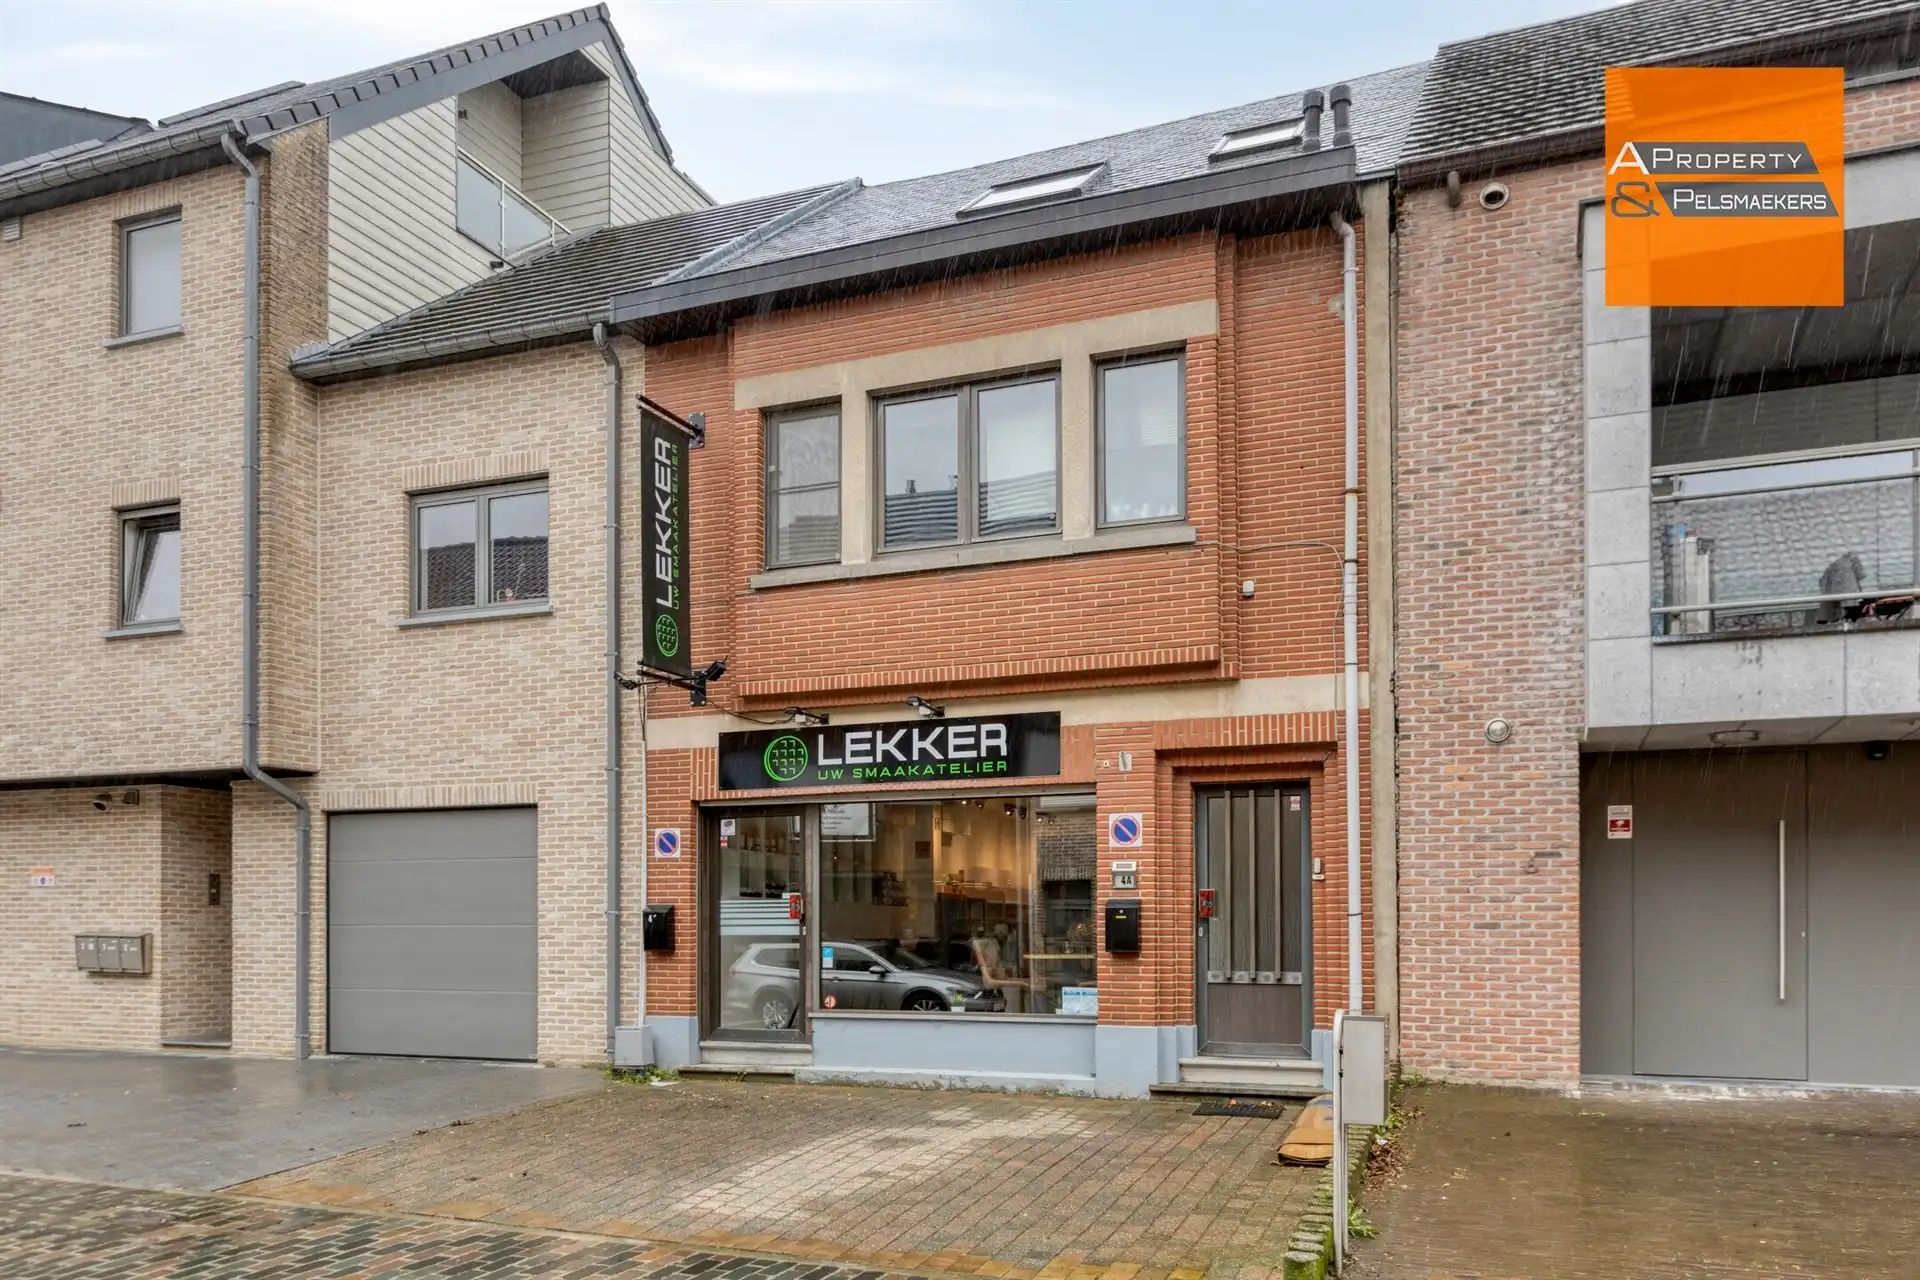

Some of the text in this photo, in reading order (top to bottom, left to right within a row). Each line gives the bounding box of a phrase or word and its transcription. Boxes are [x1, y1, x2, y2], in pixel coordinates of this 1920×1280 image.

[654, 437, 673, 608] LEKKER
[671, 444, 680, 610] UW SMAAKATELIER
[817, 723, 1008, 766] LEKKER
[817, 761, 1007, 780] UW SMAAKATELIER
[1120, 875, 1132, 885] 4A
